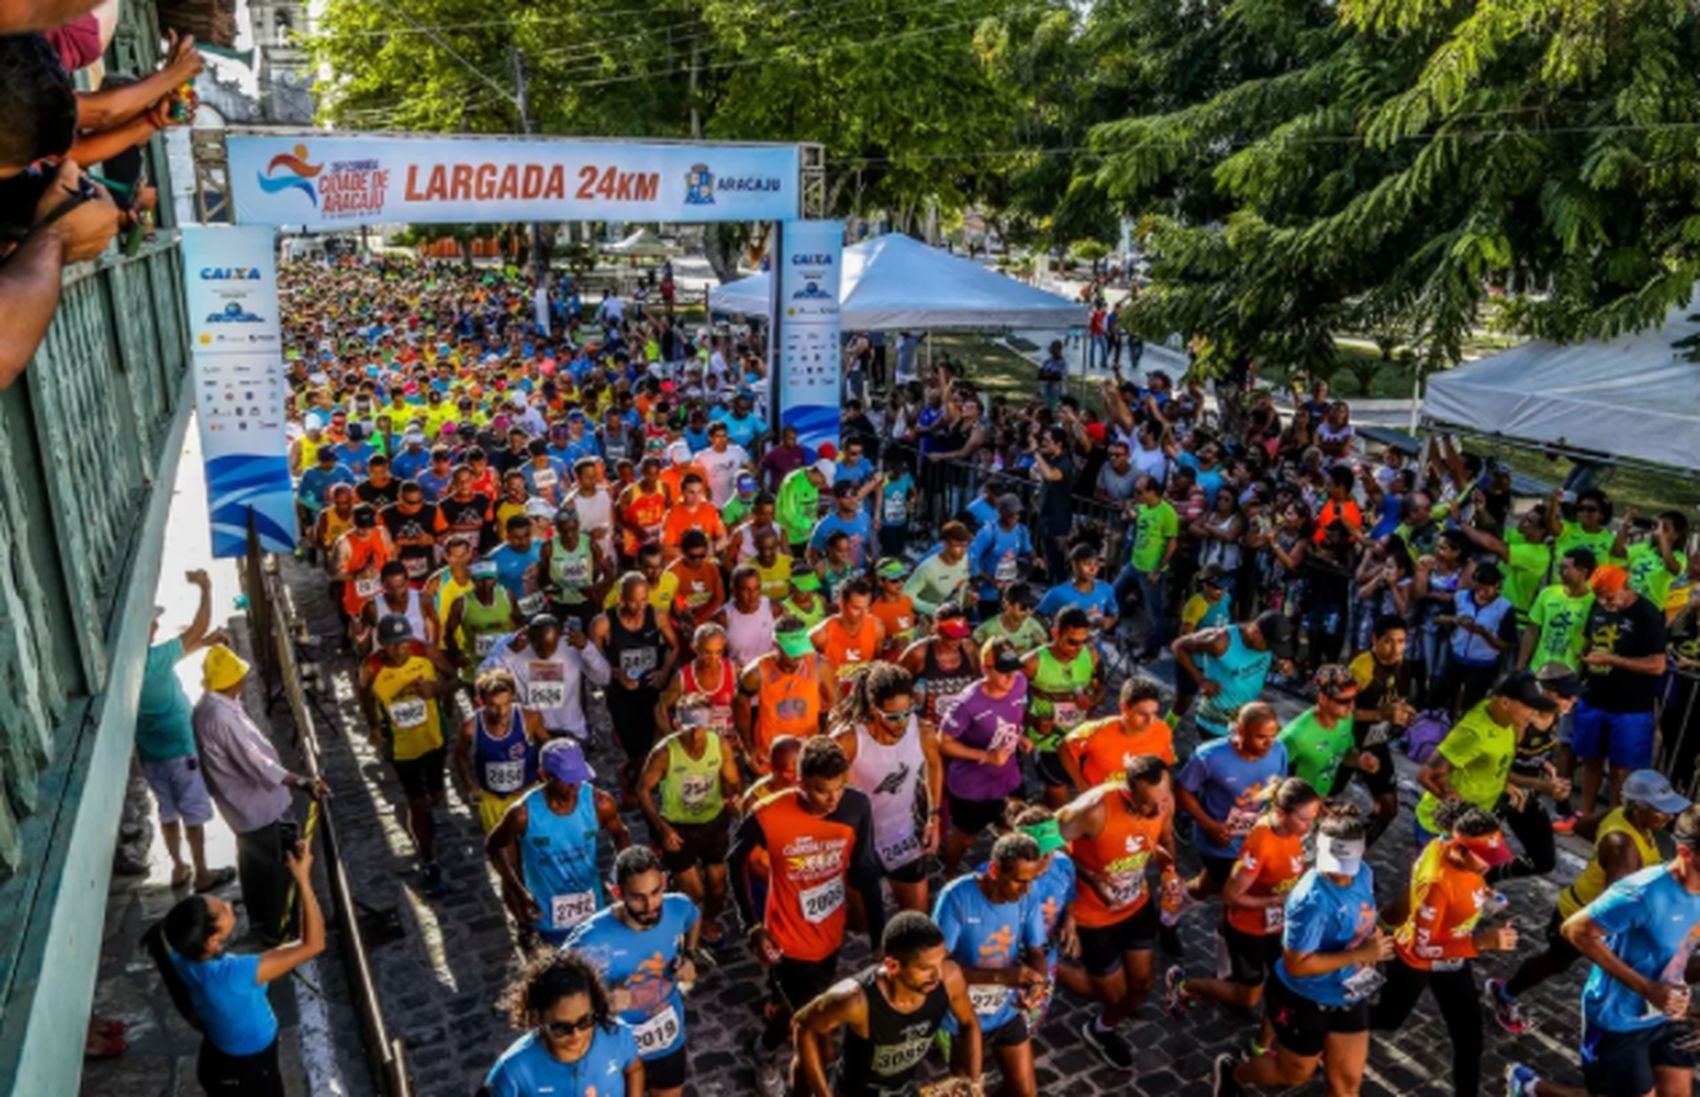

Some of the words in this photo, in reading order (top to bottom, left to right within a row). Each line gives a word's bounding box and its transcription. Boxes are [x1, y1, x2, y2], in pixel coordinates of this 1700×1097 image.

[318, 173, 367, 195] CIDADE
[371, 168, 389, 188] DE
[403, 164, 565, 202] LARGADA
[575, 165, 660, 201] 24KM
[717, 177, 780, 192] ARACAJU
[322, 189, 384, 212] ARACAJU
[792, 254, 833, 266] CAIXA
[200, 267, 261, 280] CAIXA
